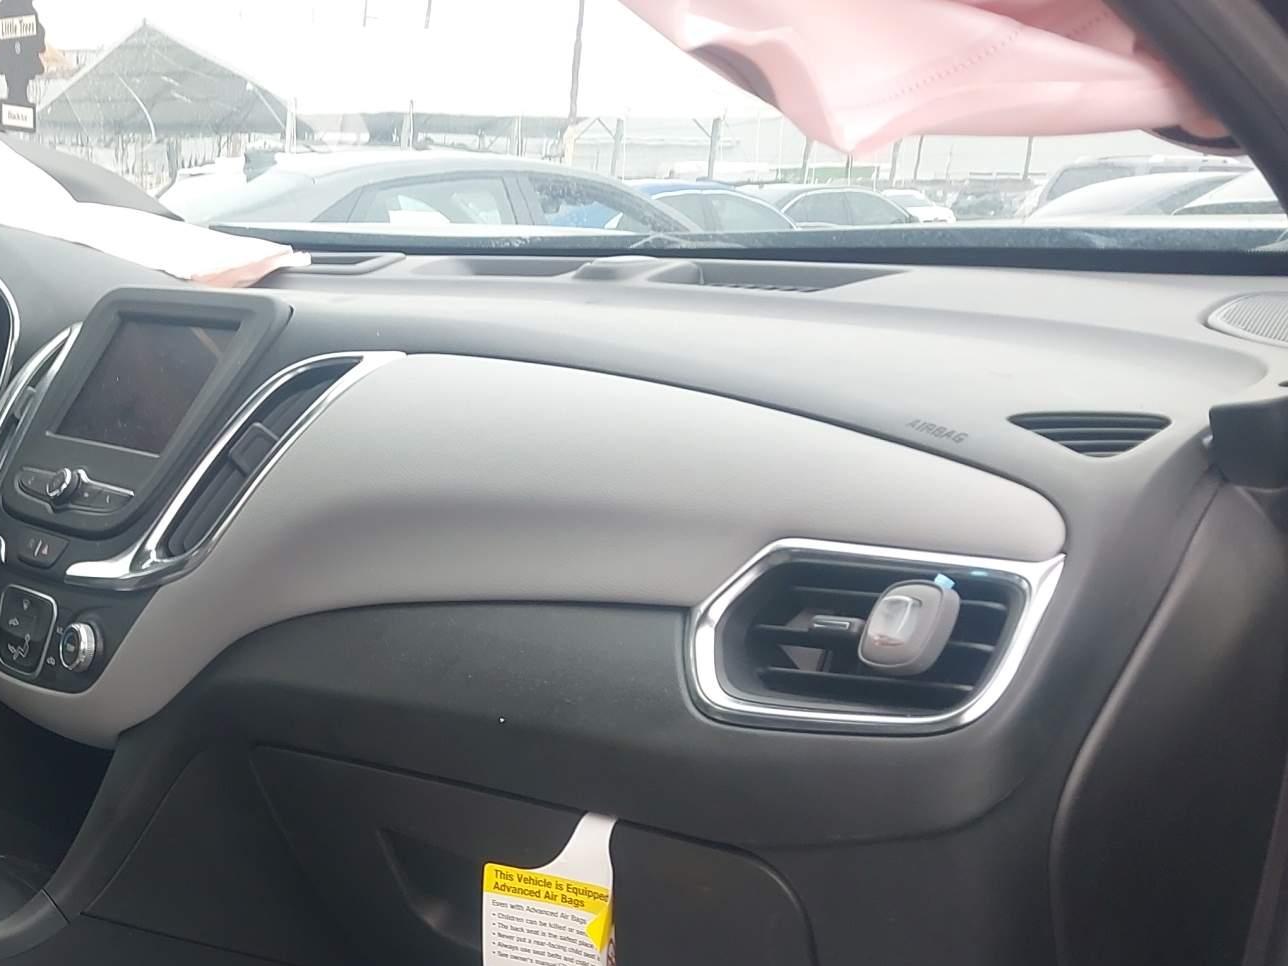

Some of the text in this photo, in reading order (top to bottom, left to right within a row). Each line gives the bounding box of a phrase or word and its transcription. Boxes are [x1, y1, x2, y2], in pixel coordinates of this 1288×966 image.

[907, 419, 968, 443] AIRBAG
[494, 869, 514, 881] This
[517, 873, 552, 889] Vehicle
[555, 881, 564, 890] is
[493, 881, 585, 908] Advanced Air Bags
[497, 912, 524, 923] Children
[549, 922, 566, 931] killed
[526, 906, 558, 918] Advanced
[560, 912, 569, 920] Air
[510, 925, 524, 933] back
[559, 935, 577, 944] safest
[497, 932, 515, 940] Never
[533, 940, 567, 953] rear-facing
[568, 946, 583, 956] child
[584, 951, 596, 960] seat
[497, 941, 519, 951] Always
[547, 951, 562, 960] belts
[510, 954, 534, 964] owner's
